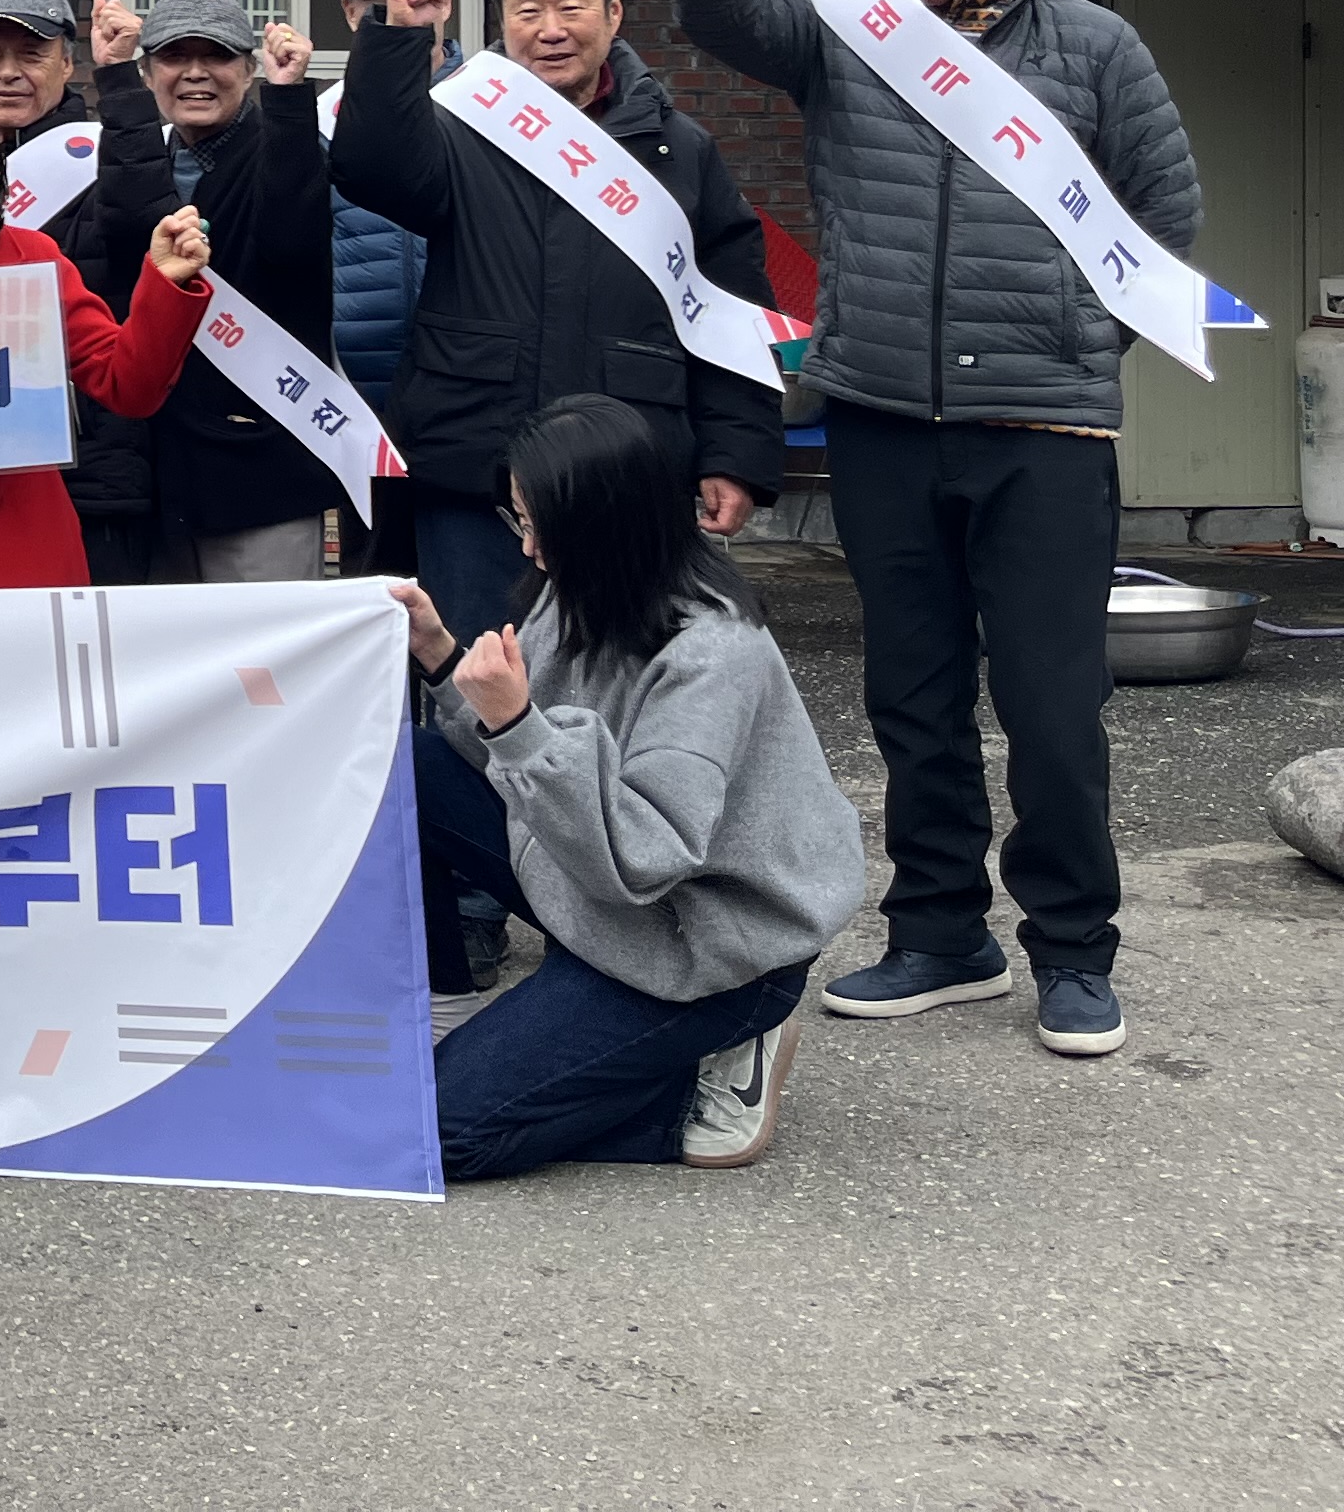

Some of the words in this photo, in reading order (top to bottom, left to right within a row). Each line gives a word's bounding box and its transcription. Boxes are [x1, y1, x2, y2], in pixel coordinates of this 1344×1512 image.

[472, 78, 640, 215] 나라사랑
[1058, 179, 1141, 284] 달기
[275, 365, 351, 436] 실천
